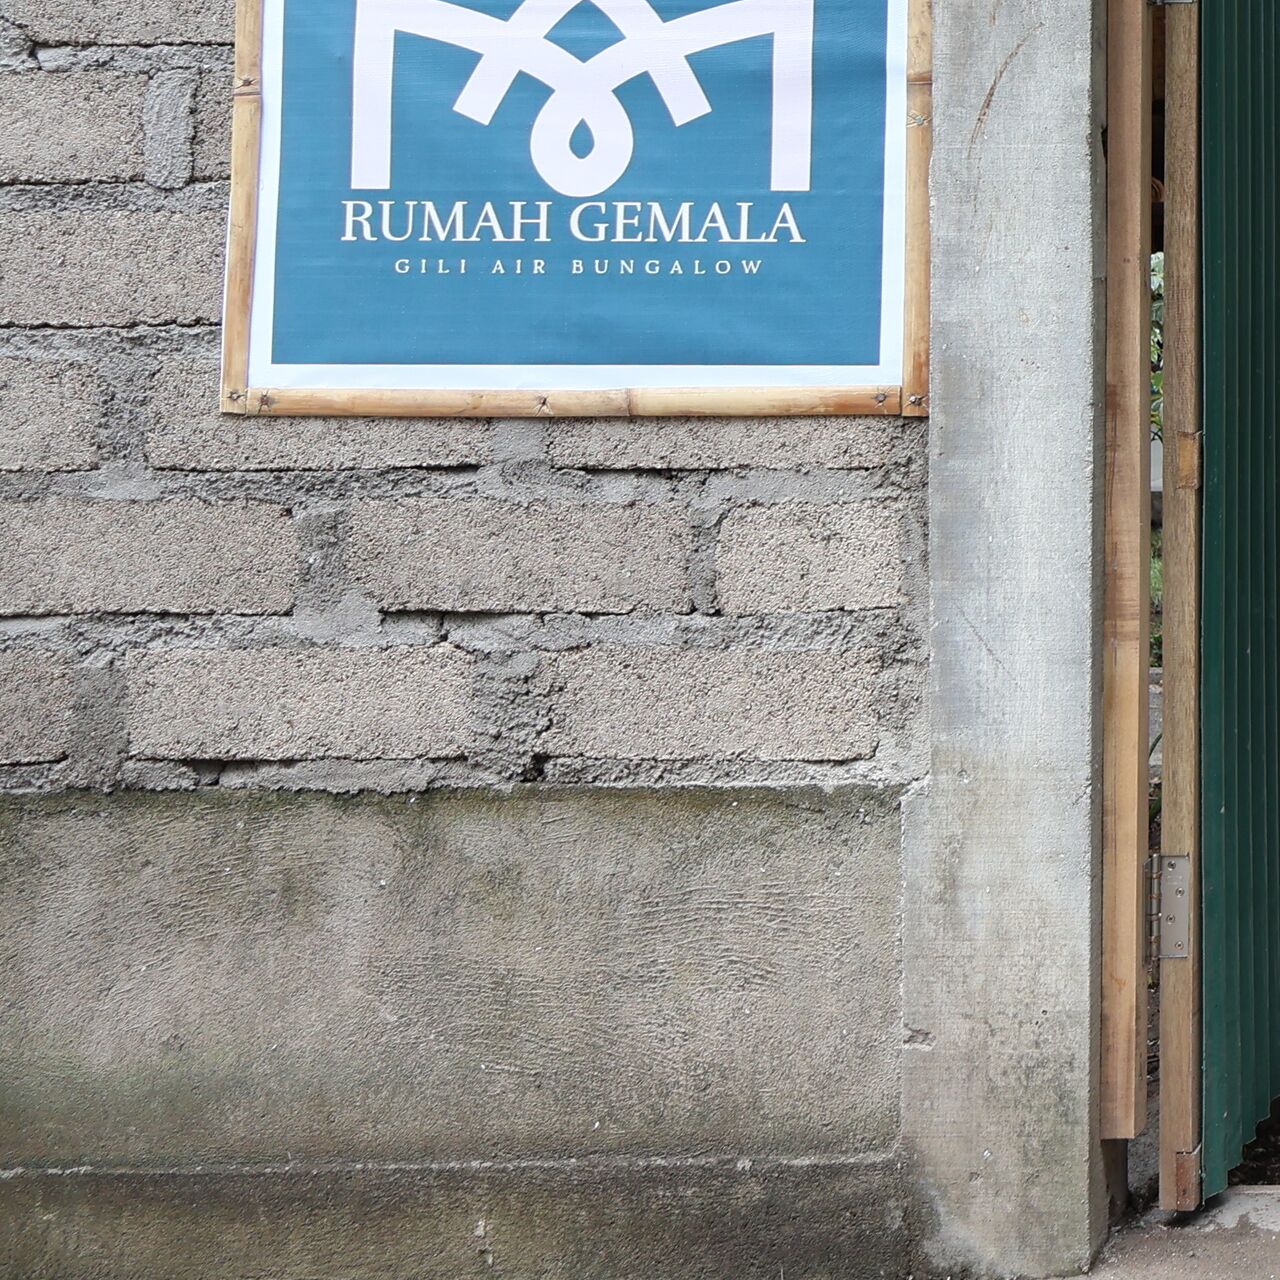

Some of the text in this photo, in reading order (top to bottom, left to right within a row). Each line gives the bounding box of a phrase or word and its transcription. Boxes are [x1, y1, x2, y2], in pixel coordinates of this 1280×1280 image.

[340, 200, 807, 243] RUMAH GEMALA
[394, 258, 762, 275] GILI AIR BUNGALOW
